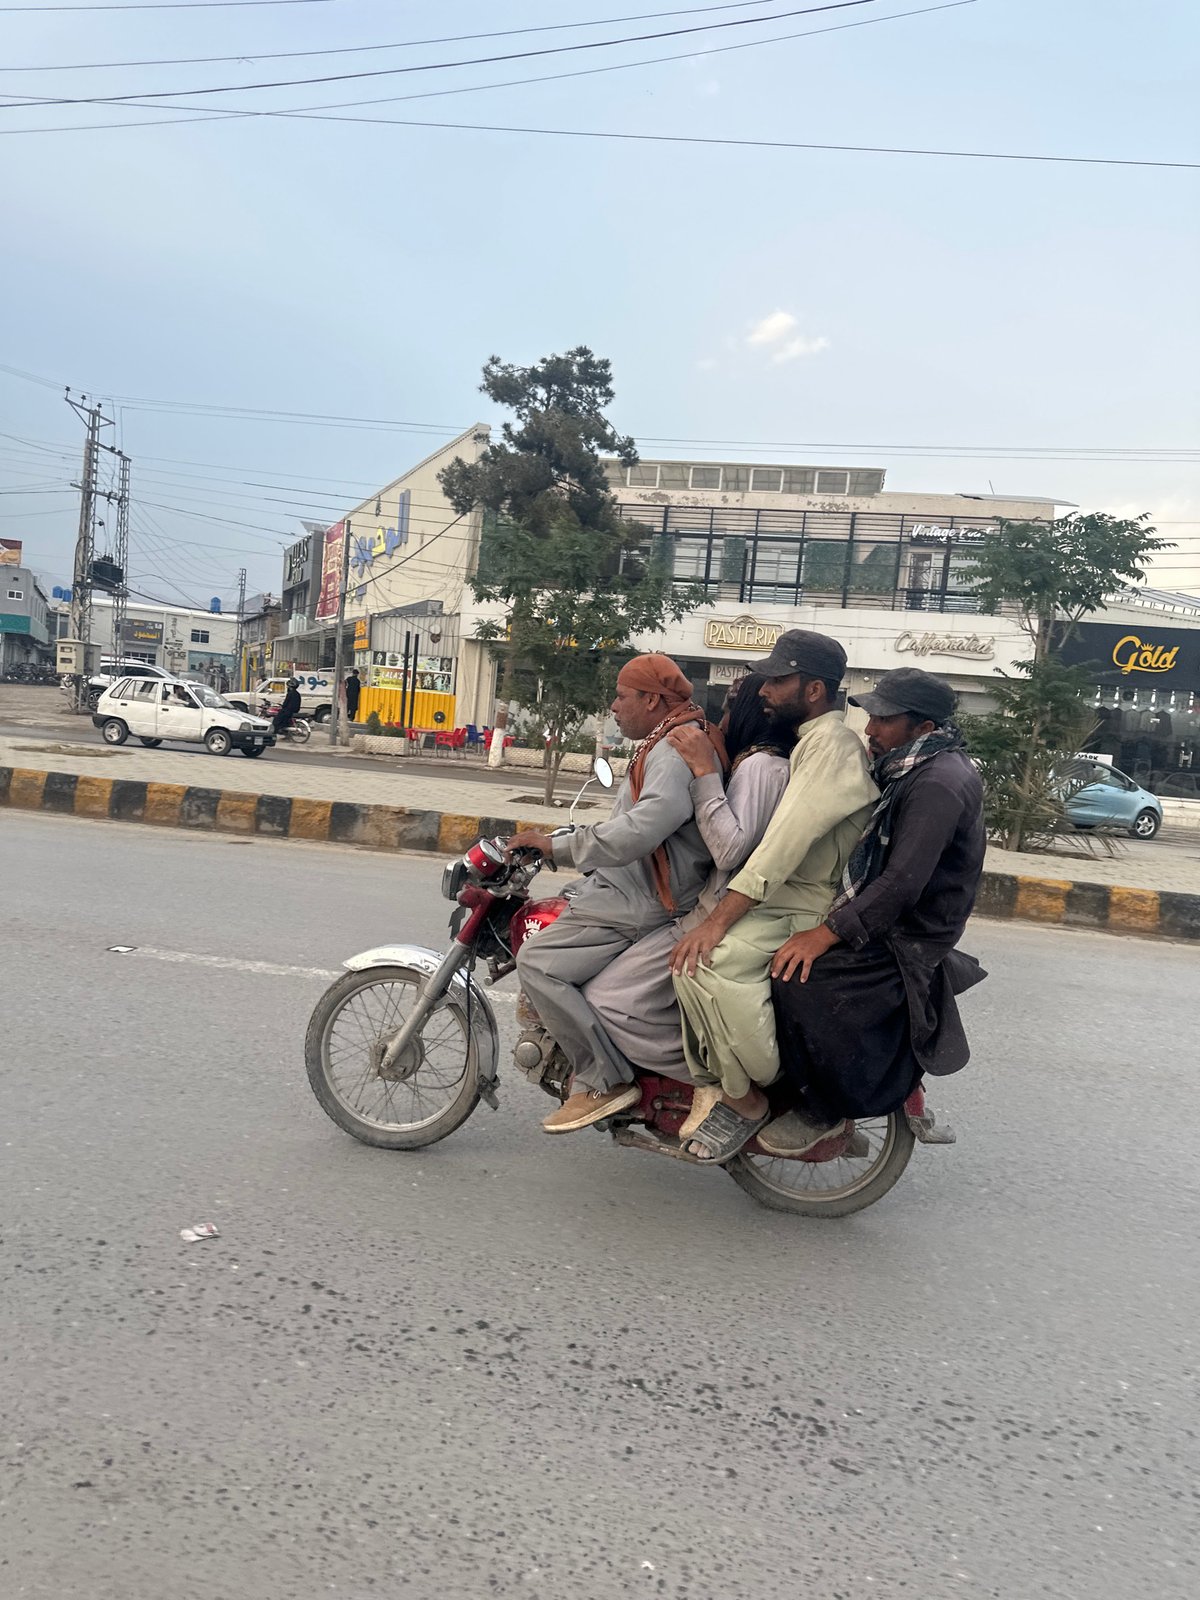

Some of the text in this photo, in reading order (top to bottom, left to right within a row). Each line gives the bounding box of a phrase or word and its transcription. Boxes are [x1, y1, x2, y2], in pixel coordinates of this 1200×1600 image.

[911, 524, 956, 541] Vintage
[709, 623, 777, 647] PASTERIA
[894, 631, 996, 661] Caffeinated
[1113, 635, 1180, 674] Gold
[714, 665, 753, 678] PASTER
